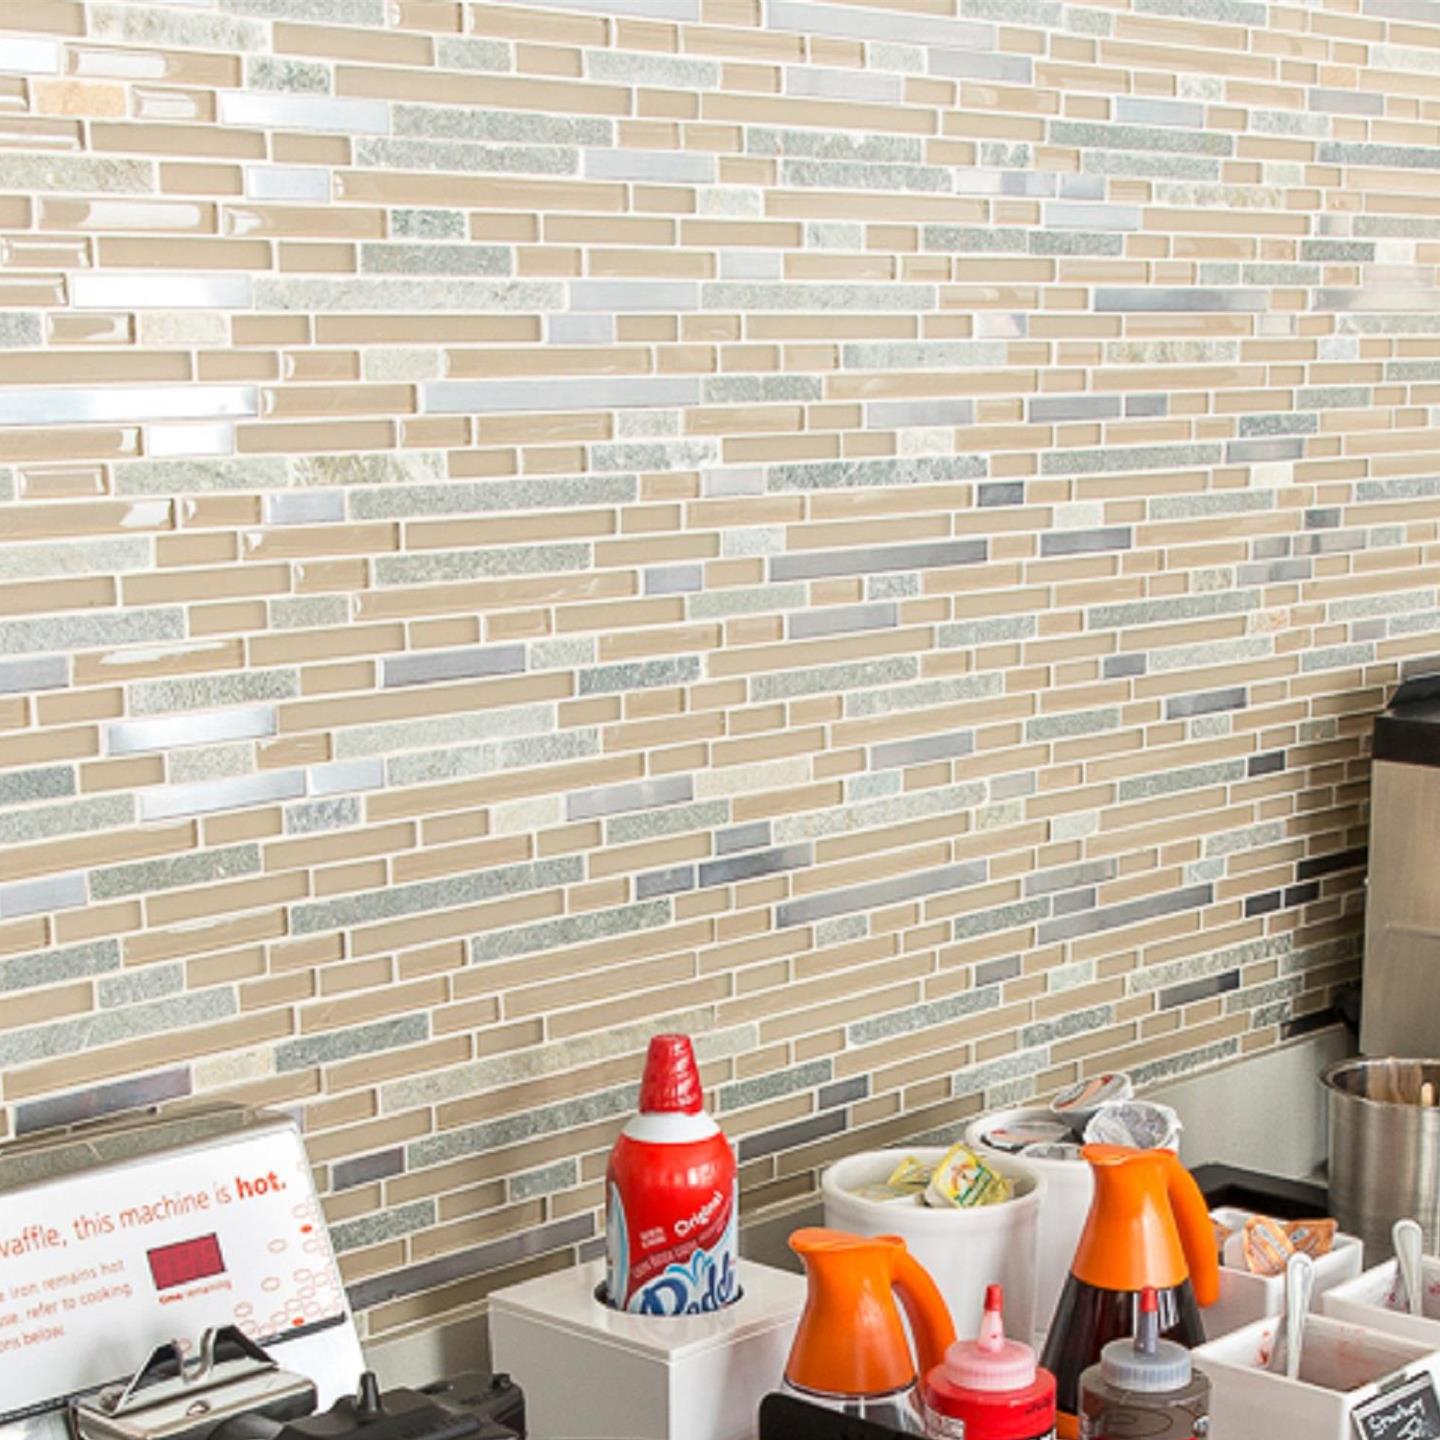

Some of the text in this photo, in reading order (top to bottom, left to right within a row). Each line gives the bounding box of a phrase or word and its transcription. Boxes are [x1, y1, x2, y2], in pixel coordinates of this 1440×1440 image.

[72, 1211, 115, 1241] this
[118, 1190, 210, 1229] machine
[213, 1181, 232, 1204] is
[234, 1170, 287, 1200] hot.
[673, 1190, 725, 1238] Original
[8, 1283, 39, 1300] iron
[41, 1266, 98, 1292] remains
[100, 1258, 125, 1277] hot
[25, 1300, 59, 1321] refer
[61, 1297, 77, 1312] to
[79, 1283, 134, 1307] cooking
